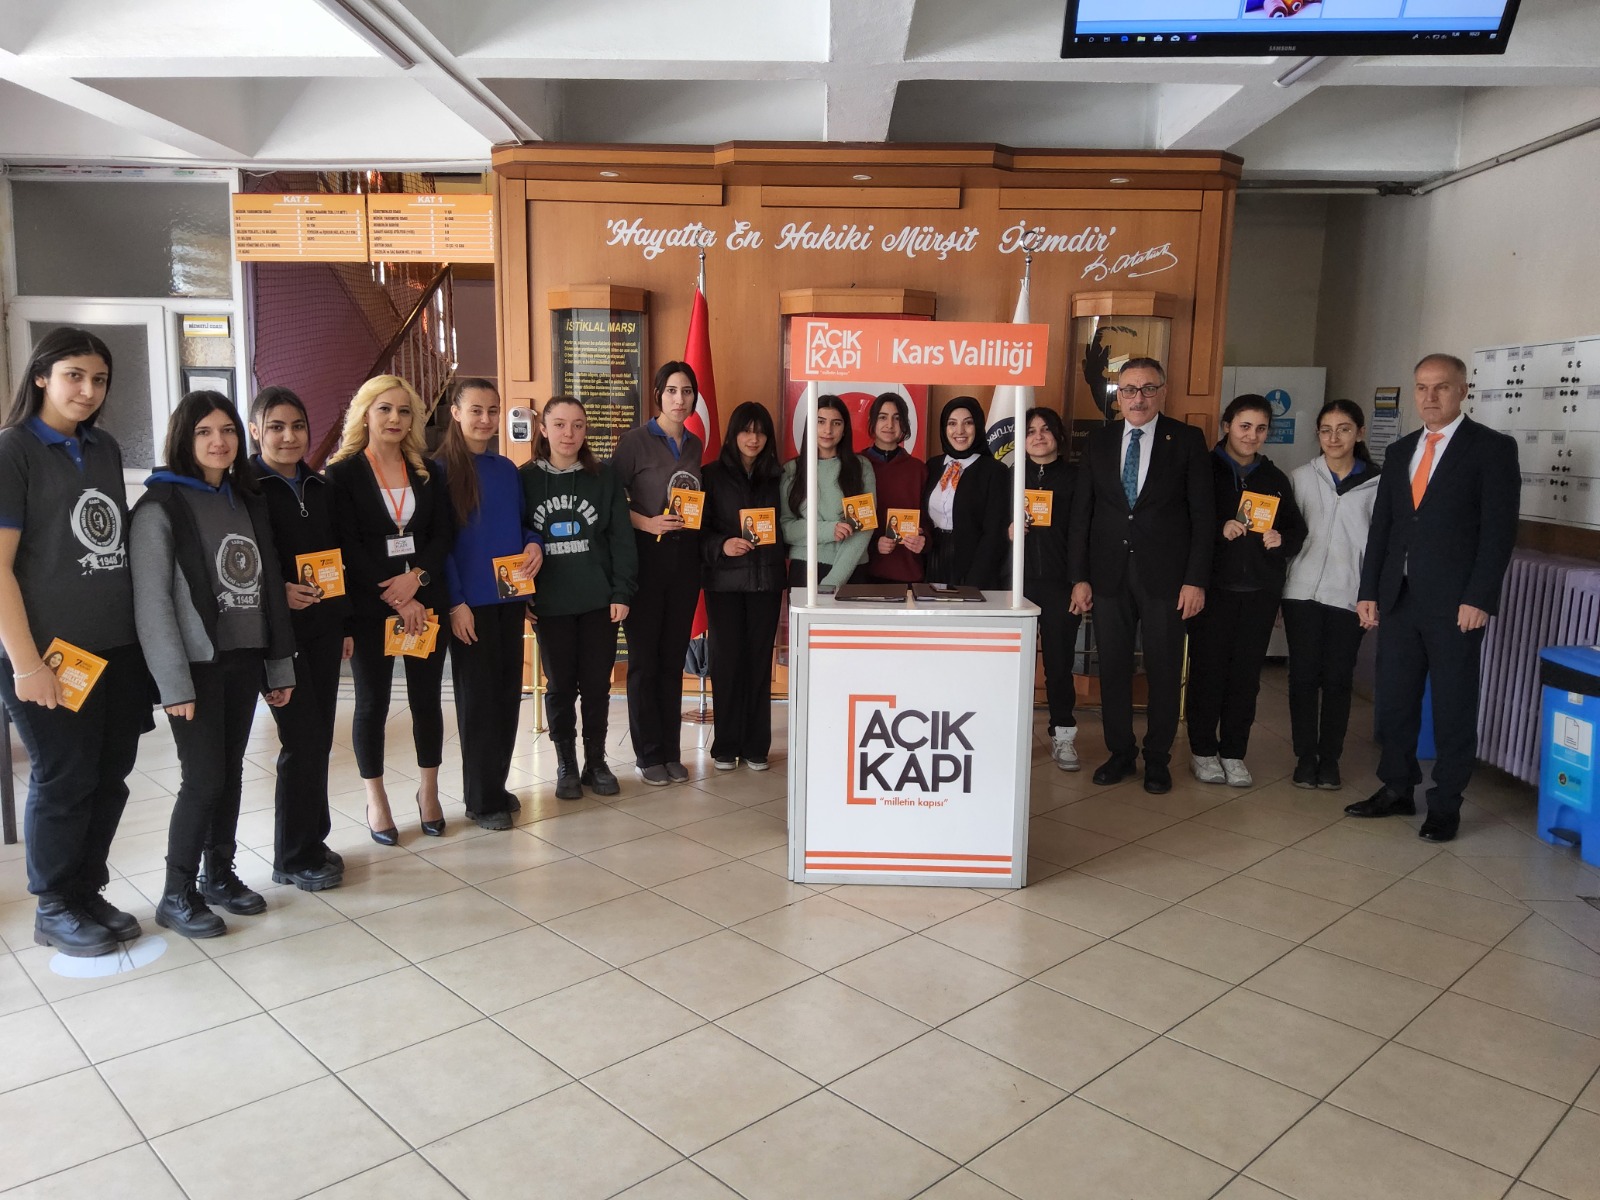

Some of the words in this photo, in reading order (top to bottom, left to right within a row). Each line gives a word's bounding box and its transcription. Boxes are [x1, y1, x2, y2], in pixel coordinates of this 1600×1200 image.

[726, 219, 764, 251] En
[774, 221, 875, 251] Hakiki
[881, 226, 980, 261] Mürşit
[566, 318, 605, 332] İSTİKLAL
[607, 322, 636, 335] MARŞI
[811, 329, 863, 350] AÇIK
[811, 349, 861, 369] KAPI
[892, 338, 945, 366] Kars
[949, 339, 1033, 375] Valiliği
[100, 556, 118, 567] 1948
[236, 595, 254, 604] 1948
[858, 709, 977, 752] AÇIK
[859, 752, 972, 793] KAPI
